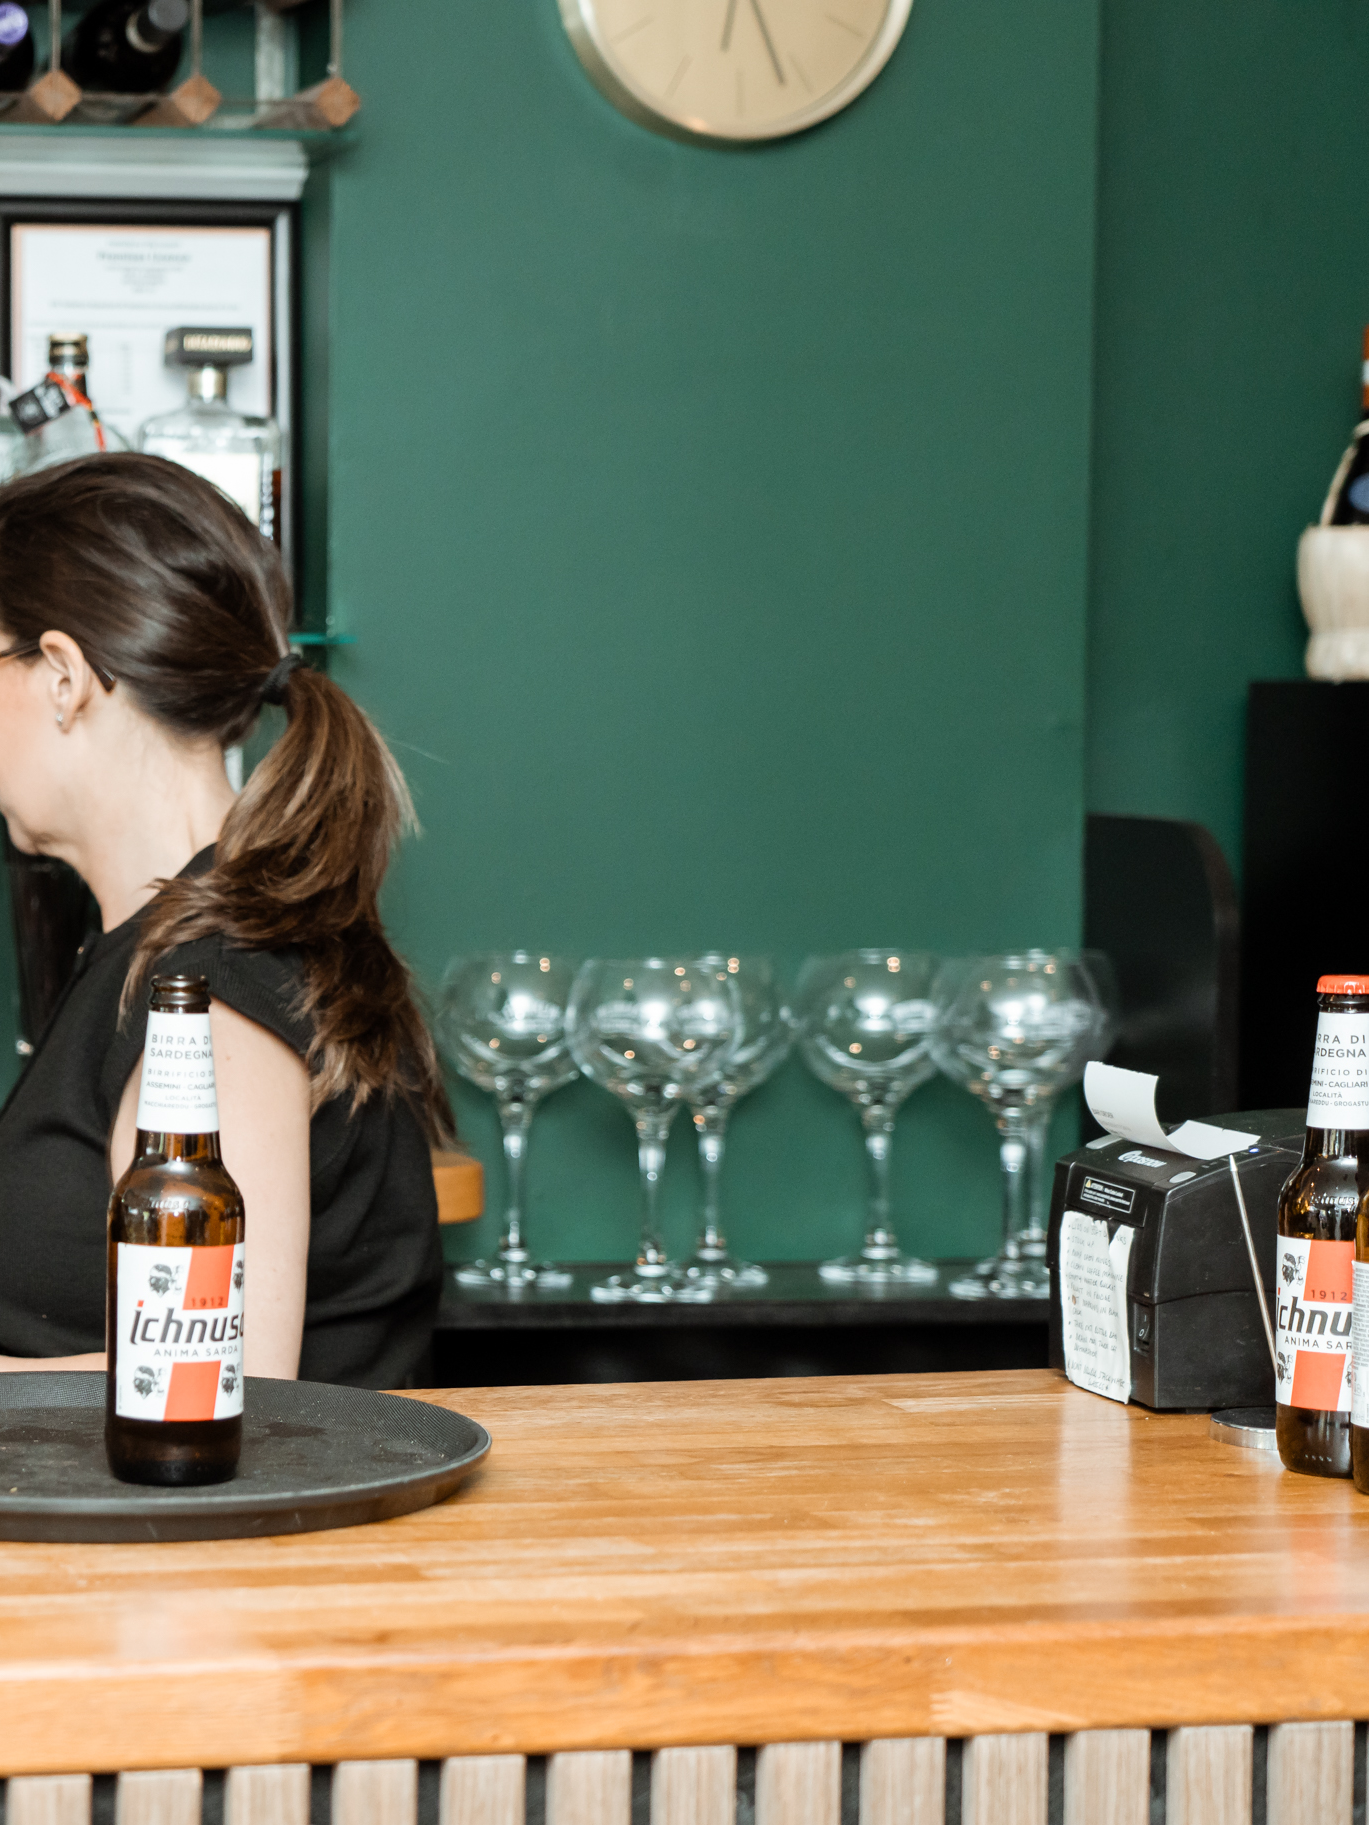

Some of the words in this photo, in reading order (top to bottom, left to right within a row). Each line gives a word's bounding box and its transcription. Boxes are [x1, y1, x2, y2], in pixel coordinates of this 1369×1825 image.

[152, 1033, 197, 1046] BIRRA
[1317, 1033, 1341, 1045] RRA
[1350, 1034, 1366, 1045] DI
[150, 1047, 213, 1060] SARDEGNA
[1315, 1047, 1367, 1058] RDEGNA
[147, 1068, 206, 1078] BIRRIFICIO
[1356, 1068, 1368, 1076] DI
[187, 1082, 216, 1091] CAGLIAR
[1311, 1289, 1348, 1301] 1912
[191, 1297, 224, 1307] 1912
[1276, 1287, 1353, 1337] ichnu
[1284, 1336, 1320, 1349] ANIMA
[1326, 1340, 1352, 1351] SAR
[154, 1349, 199, 1358] ANIMA
[205, 1345, 239, 1357] SARDA
